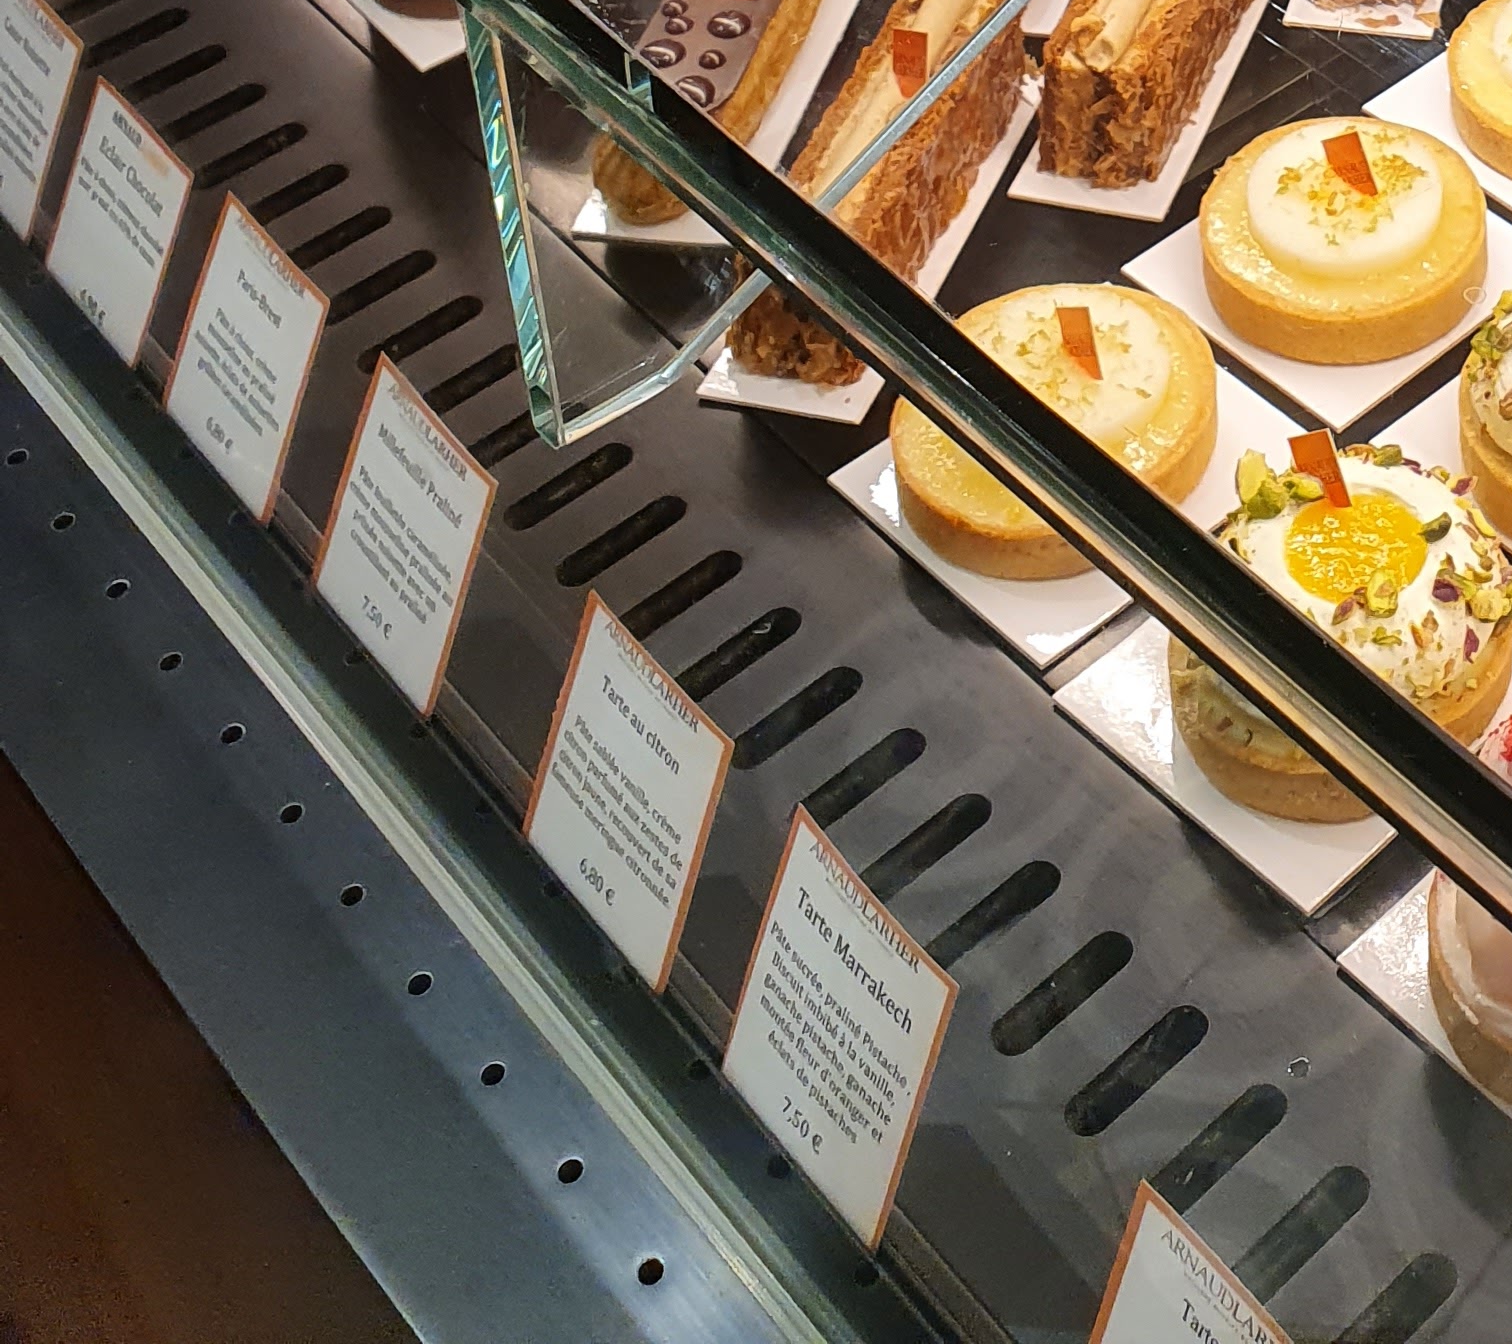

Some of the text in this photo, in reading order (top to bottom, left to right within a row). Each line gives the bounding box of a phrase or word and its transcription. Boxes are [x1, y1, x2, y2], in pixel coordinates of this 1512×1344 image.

[602, 674, 630, 719] Tarte
[629, 713, 645, 736] au
[646, 731, 680, 775] citron
[770, 920, 792, 954] Pâte
[798, 887, 833, 943] Tarte
[834, 936, 912, 1034] Marrakech
[763, 973, 803, 1025] ganache
[845, 1074, 891, 1126] ganache
[771, 950, 804, 999] Biscuit
[803, 992, 839, 1040] imbibé
[846, 1040, 857, 1062] la
[858, 1057, 895, 1107] vanille,
[796, 1067, 809, 1087] de
[782, 1095, 823, 1155] 7,50 €
[795, 1036, 821, 1071] fleur
[871, 1127, 883, 1144] et
